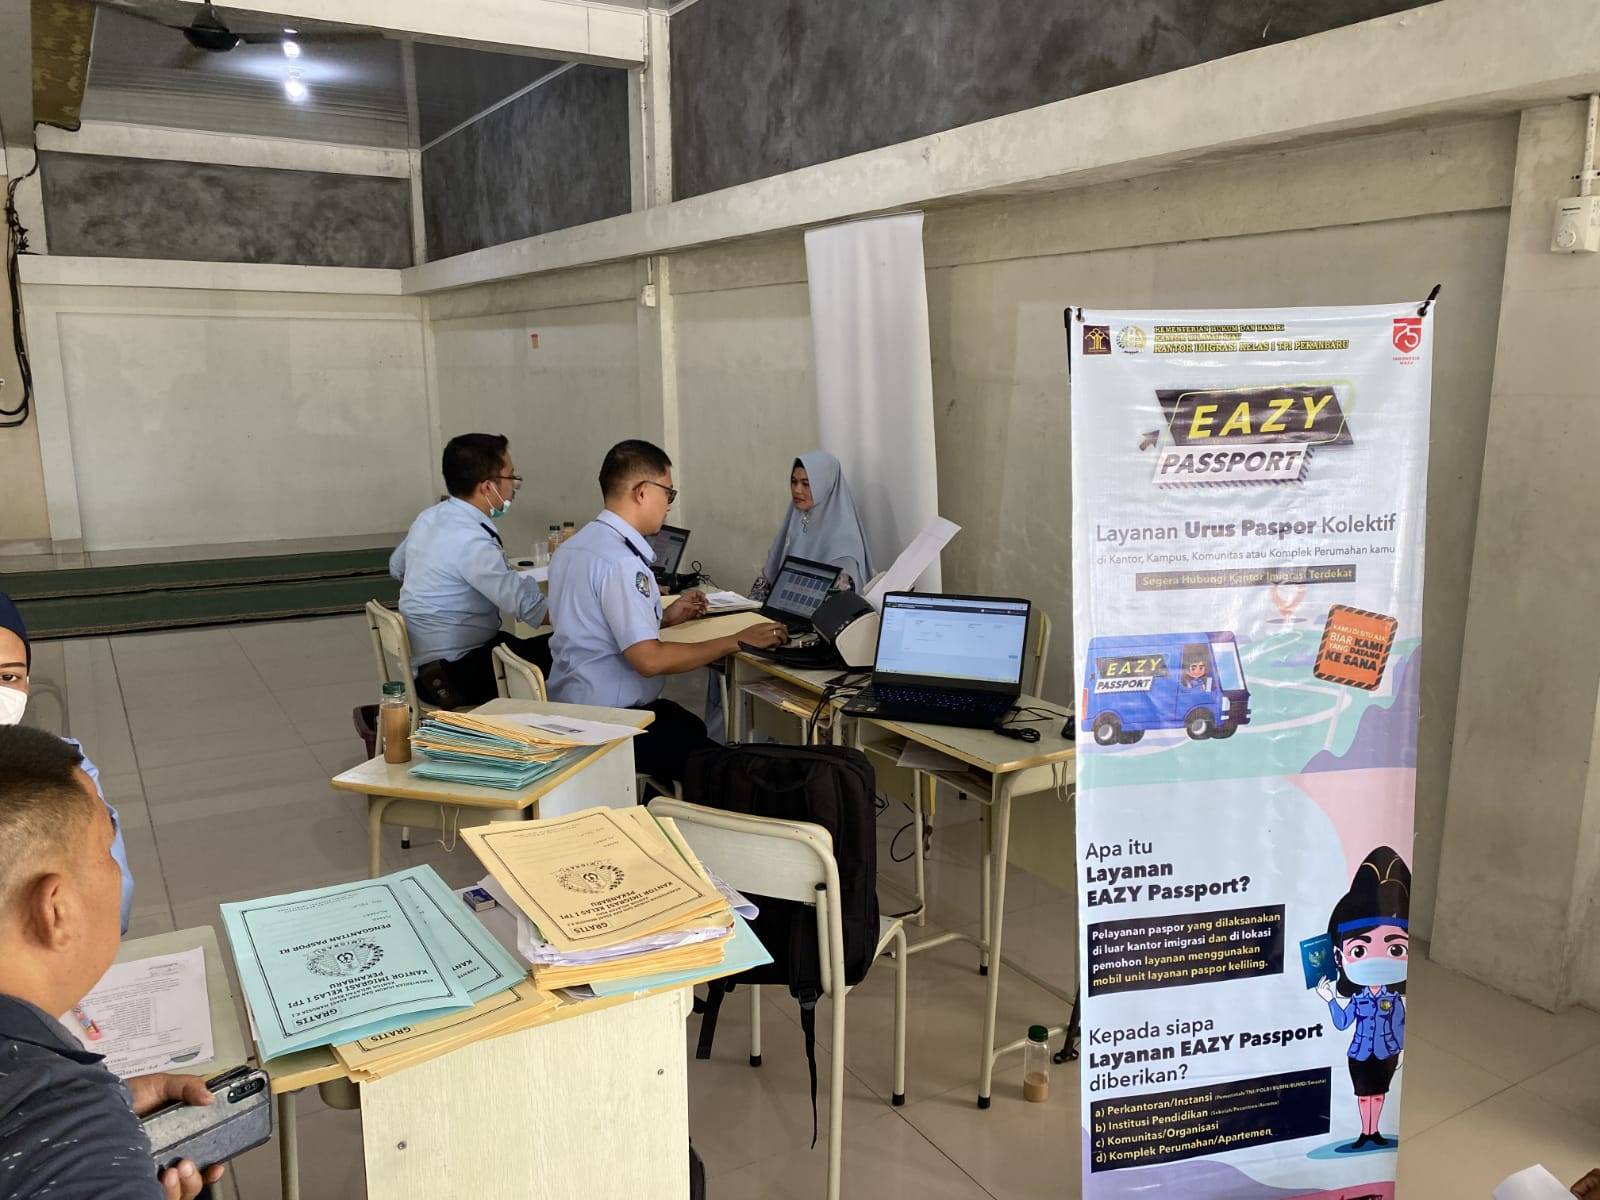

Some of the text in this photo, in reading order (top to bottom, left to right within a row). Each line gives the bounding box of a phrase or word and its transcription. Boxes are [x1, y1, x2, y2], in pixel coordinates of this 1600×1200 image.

[1154, 344, 1194, 353] KANTOR
[1194, 343, 1237, 352] IMIGRASI
[1239, 342, 1269, 352] KELAS
[1277, 342, 1292, 350] TPI
[1294, 340, 1350, 350] PEKANBARU
[1188, 394, 1333, 440] EAZY
[1160, 450, 1302, 475] PASSPORT
[1096, 513, 1397, 546] Layanan Urus Paspor Kolektif
[1097, 544, 1396, 564] di Kantor, Kampus, Komunitas atau Komplek Perumahan kamu
[1143, 576, 1180, 587] Segera
[1309, 568, 1352, 579] Terdekat
[1328, 642, 1380, 660] YANG DATANG
[1330, 632, 1384, 652] BIAR KAMI
[1106, 658, 1162, 676] EAZY
[1325, 650, 1376, 671] KE SANA
[1096, 680, 1152, 690] PASSPORT
[1086, 839, 1152, 862] Apa itu
[1087, 861, 1173, 883] Layanan
[1087, 876, 1250, 907] EAZY Passport?
[330, 923, 392, 942] PENGGANTIAN
[573, 922, 608, 934] GRATIS
[1092, 914, 1280, 940] Pelayanan paspor yang dilaksanakan
[293, 940, 328, 952] PASPOR
[1092, 928, 1271, 956] di luar kantor imigrasi dan di lokasi
[1092, 946, 1260, 974] pemohon layanan menggunakan
[330, 970, 384, 990] PEKANBARU
[392, 969, 428, 980] KANTOR
[1093, 960, 1268, 986] mobil unit layanan paspor keliling.
[346, 976, 390, 991] IMIGRASI
[314, 988, 344, 1001] KELAS
[288, 1001, 306, 1009] TPI
[296, 1008, 338, 1026] GRATIS
[370, 1026, 412, 1042] GRATIS
[1089, 1017, 1214, 1046] Kepada siapa
[1089, 1023, 1324, 1069] Layanan EAZY Passport
[1089, 1065, 1188, 1092] diberikan?
[1095, 1108, 1104, 1118] a)
[1107, 1092, 1212, 1116] Perkantoran/Instansi
[1095, 1122, 1106, 1133] b)
[1108, 1116, 1150, 1130] Institusi
[1152, 1110, 1208, 1125] Pendidikan
[1096, 1120, 1219, 1148] c) Komunitas/Organisasi
[1096, 1151, 1106, 1163] d)
[1109, 1146, 1156, 1160] Komplek
